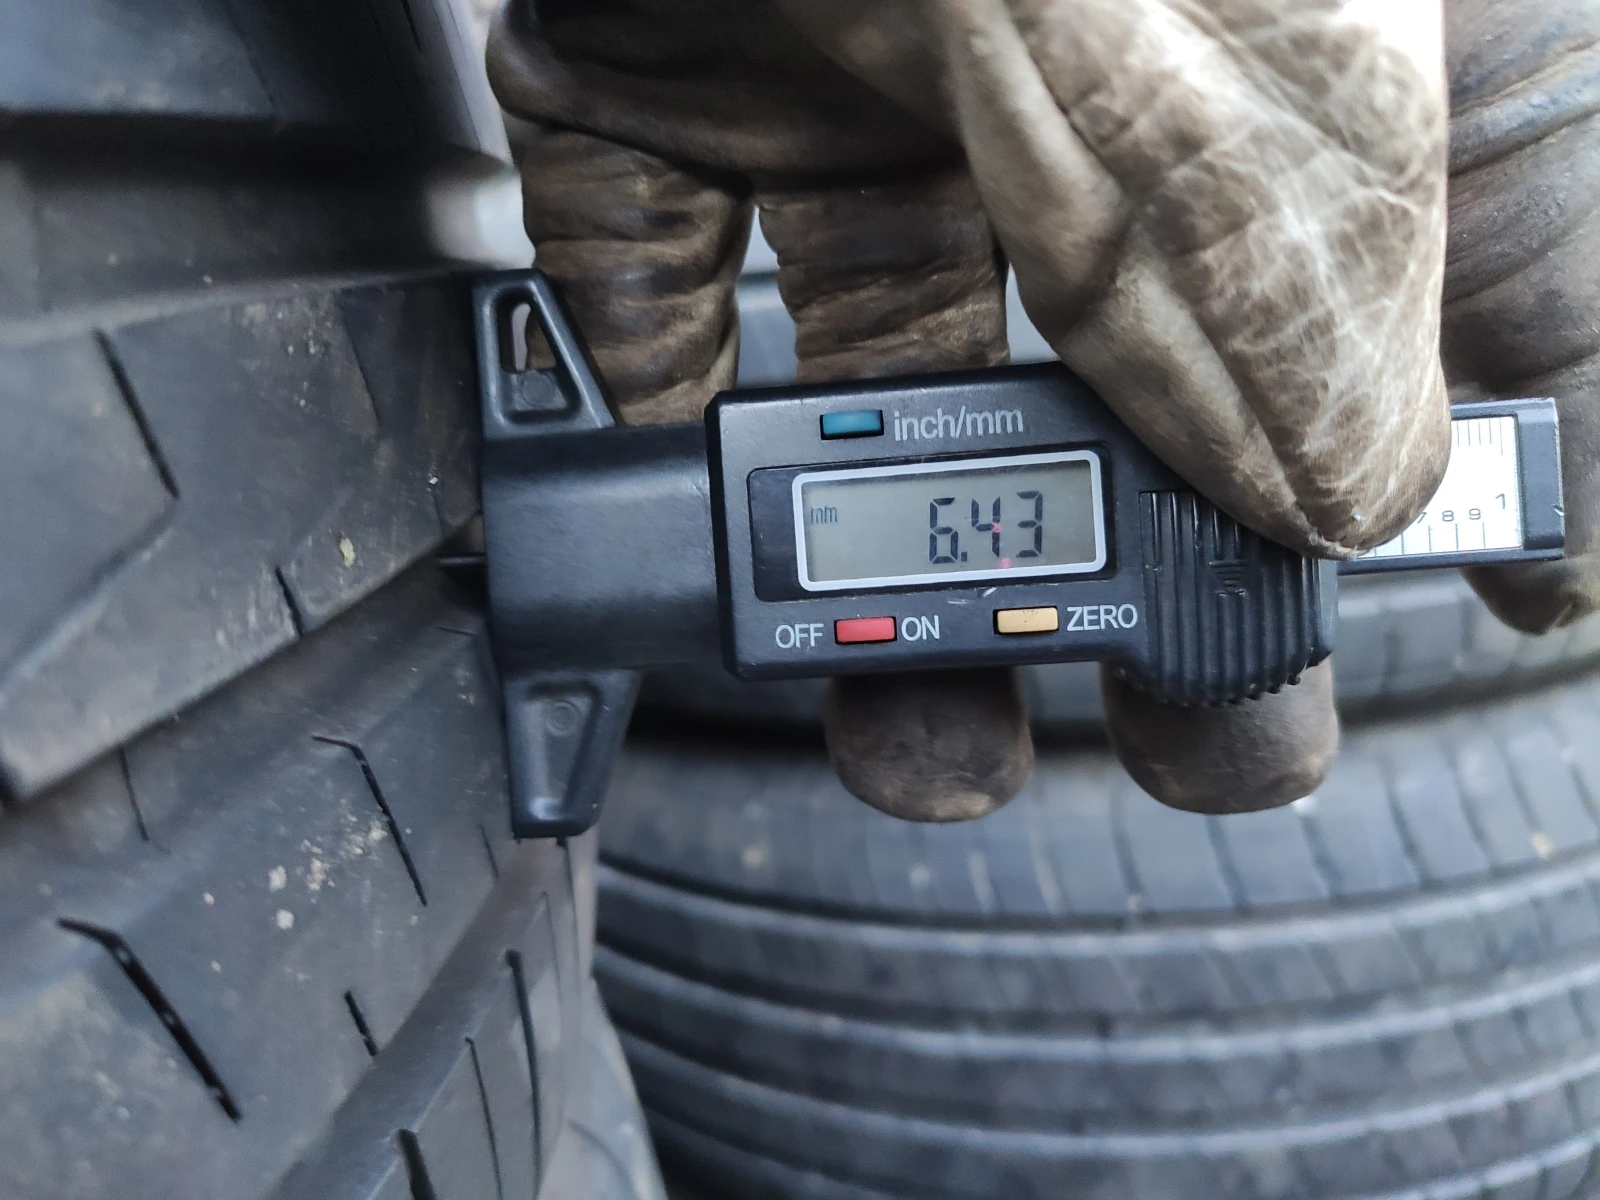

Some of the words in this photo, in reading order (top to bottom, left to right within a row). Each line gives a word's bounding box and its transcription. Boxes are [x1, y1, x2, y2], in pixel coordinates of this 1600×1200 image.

[893, 405, 1024, 441] inch/mm
[810, 504, 838, 525] mm
[1441, 510, 1455, 523] 8
[1468, 508, 1482, 521] 9
[1495, 493, 1506, 510] 1
[928, 490, 1043, 564] 6.43
[901, 615, 940, 642] ON
[1066, 603, 1138, 632] ZERO
[775, 623, 825, 649] OFF
